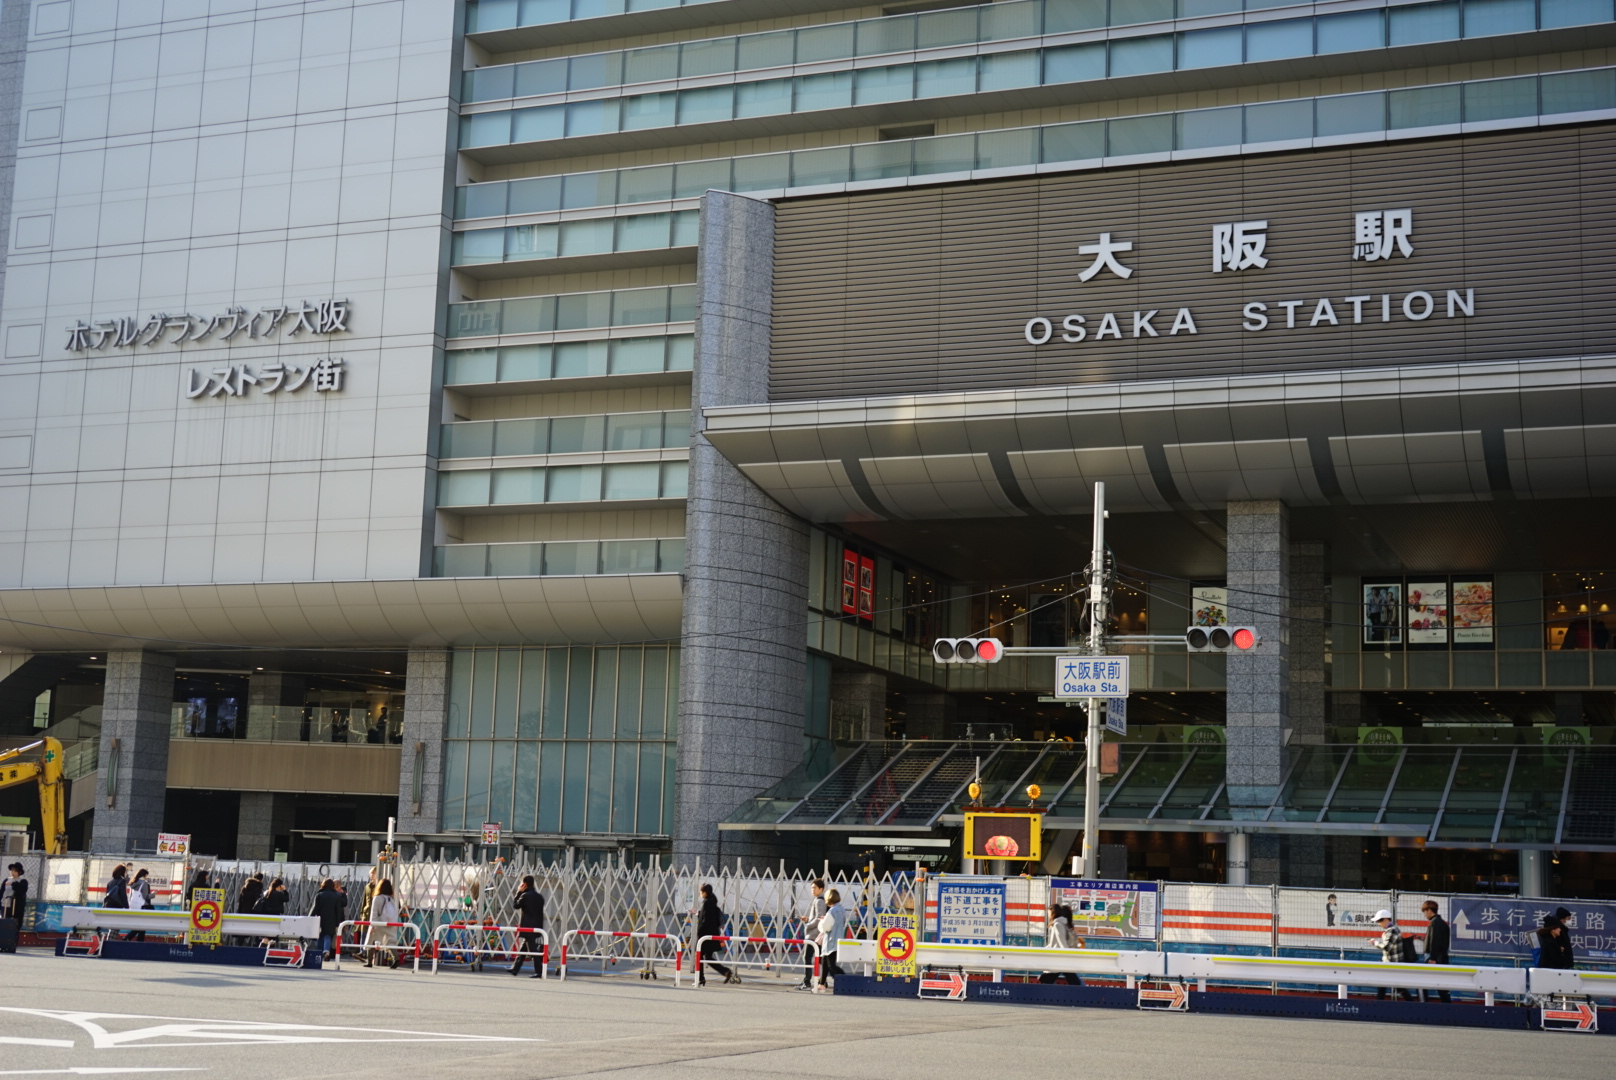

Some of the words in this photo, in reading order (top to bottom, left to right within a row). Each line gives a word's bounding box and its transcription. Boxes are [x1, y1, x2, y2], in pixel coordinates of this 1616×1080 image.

[1077, 208, 1414, 283] 大阪駅
[1024, 307, 1198, 345] OSAKA
[1242, 288, 1475, 331] STATION
[65, 298, 349, 352] ホテルグランヴィア大阪
[186, 356, 343, 400] レストラン街
[1064, 661, 1121, 680] 大阪駅前
[1063, 682, 1096, 693] Osaka
[1101, 682, 1121, 693] Sta.
[487, 831, 493, 844] 5
[168, 842, 176, 854] 4
[942, 886, 1001, 894] ご迷惑をおかけします
[1070, 881, 1138, 890] 工事エリア周辺案内図
[194, 889, 222, 902] 駐停車禁止
[944, 895, 999, 906] 地下道工事を
[944, 906, 999, 915] 行っています
[880, 915, 915, 929] 駐停車禁止
[878, 958, 914, 967] ご協力よろしく
